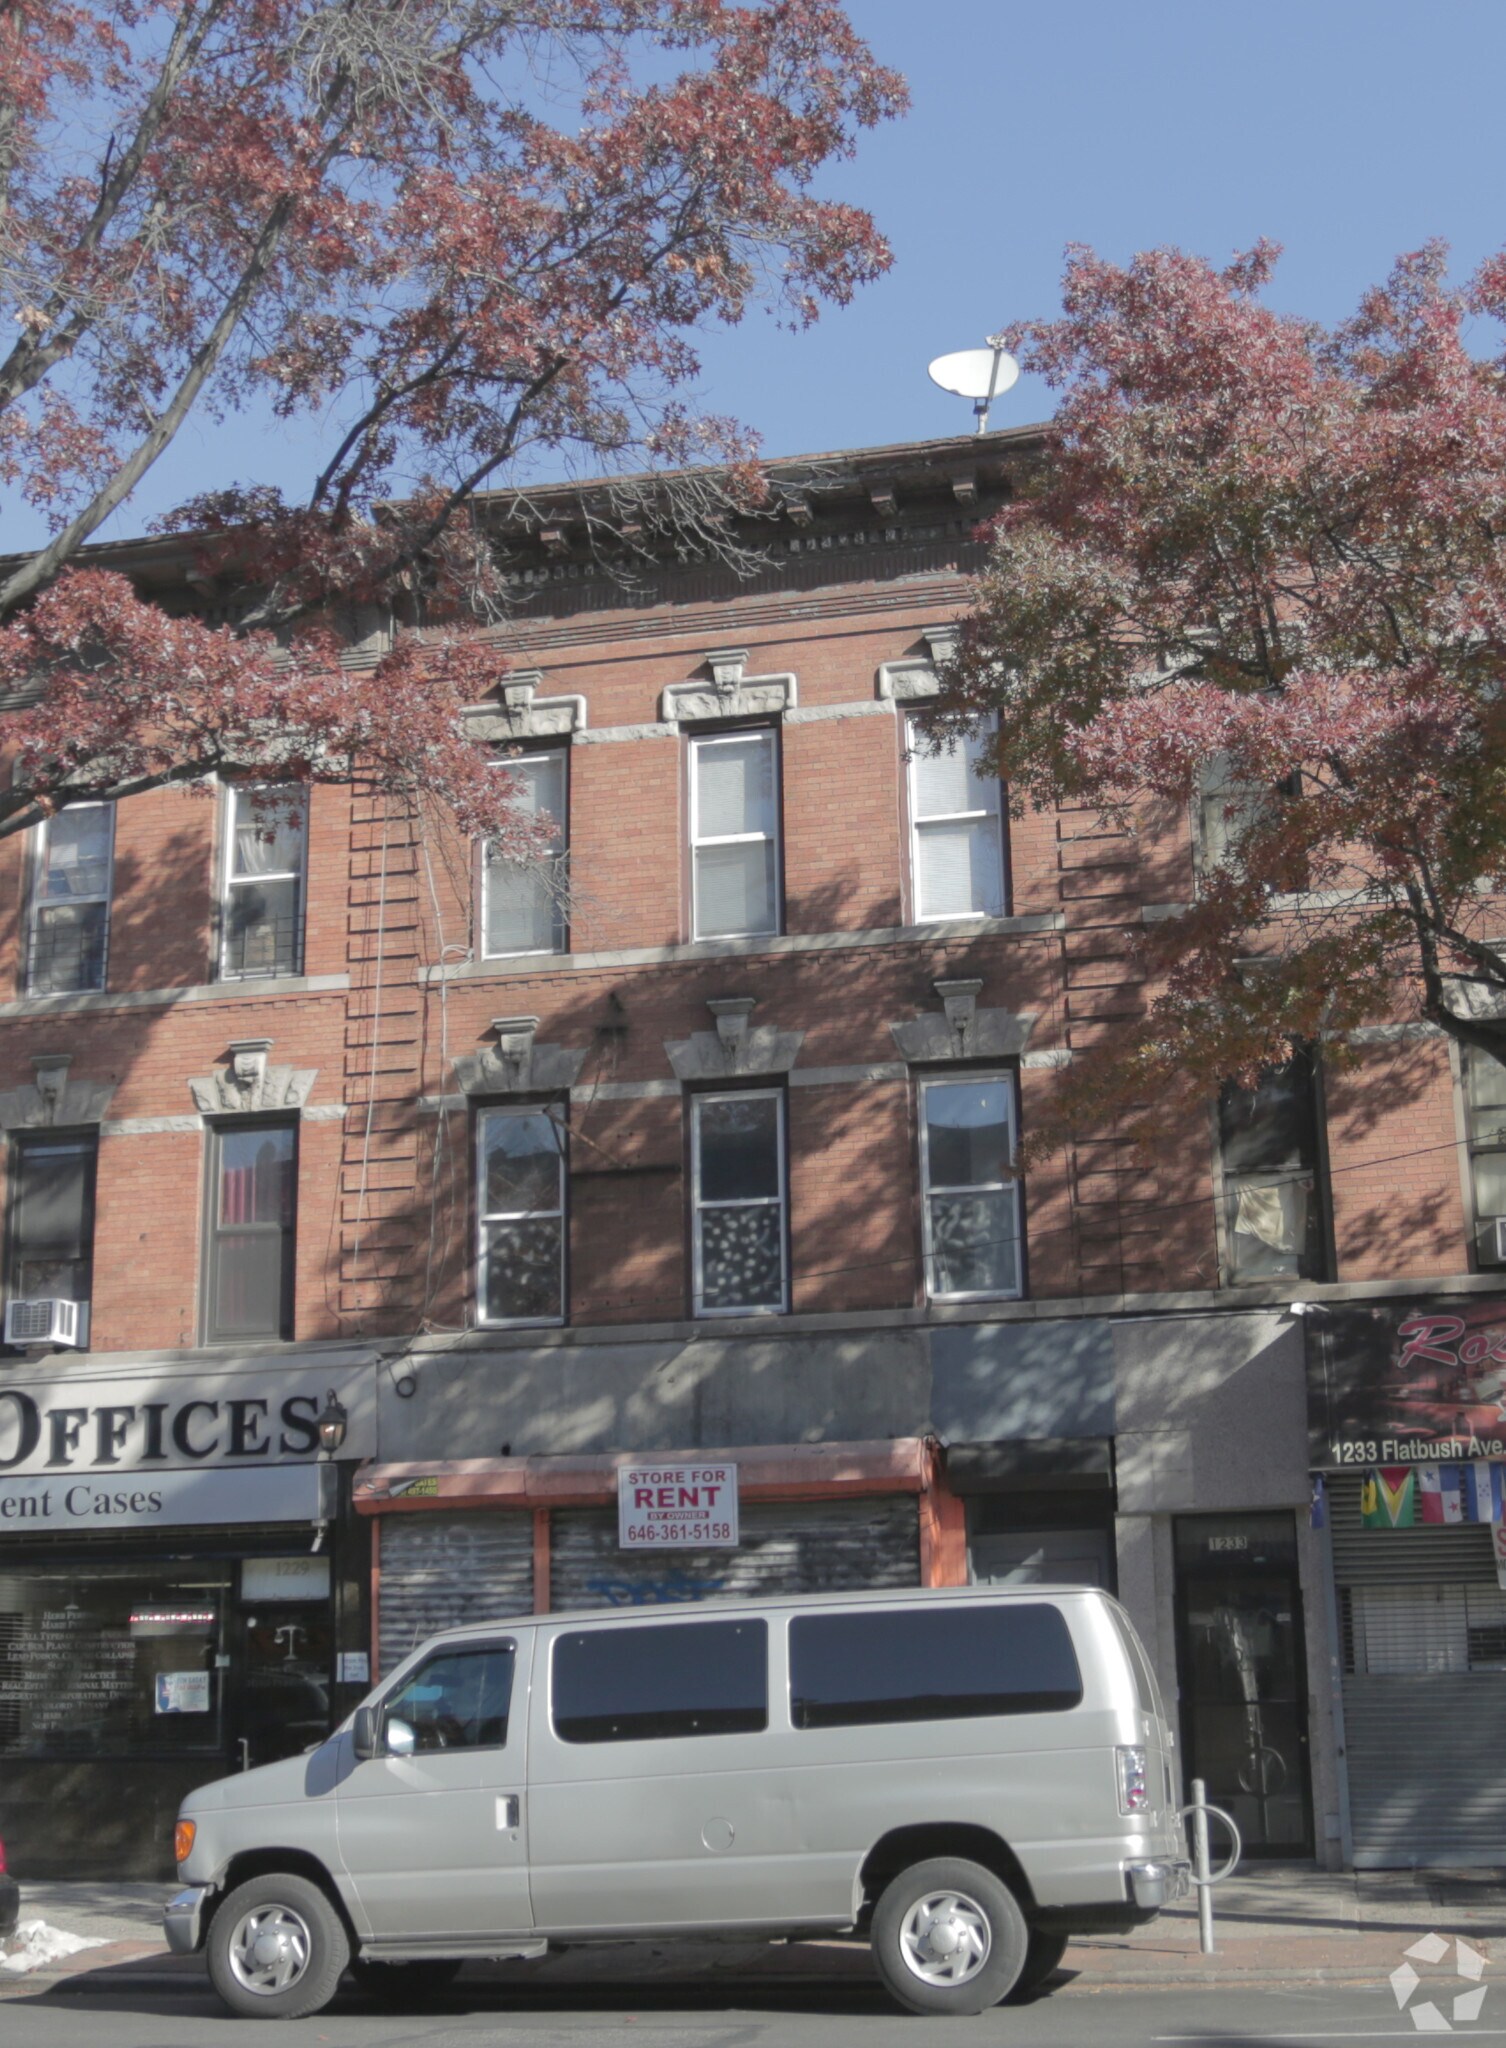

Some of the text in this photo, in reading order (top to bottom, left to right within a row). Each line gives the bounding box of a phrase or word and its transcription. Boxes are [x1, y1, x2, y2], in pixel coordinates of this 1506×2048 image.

[0, 1390, 320, 1469] OFFICES
[1331, 1441, 1377, 1463] 1233
[1382, 1437, 1462, 1461] Flatbush
[629, 1470, 726, 1485] STORE FOR
[64, 1485, 163, 1516] Cases
[634, 1486, 721, 1509] RENT
[650, 1511, 706, 1520] BY OWNER
[628, 1523, 730, 1541] 646-361-5158
[1211, 1536, 1246, 1550] 1233
[275, 1560, 310, 1577] 1229
